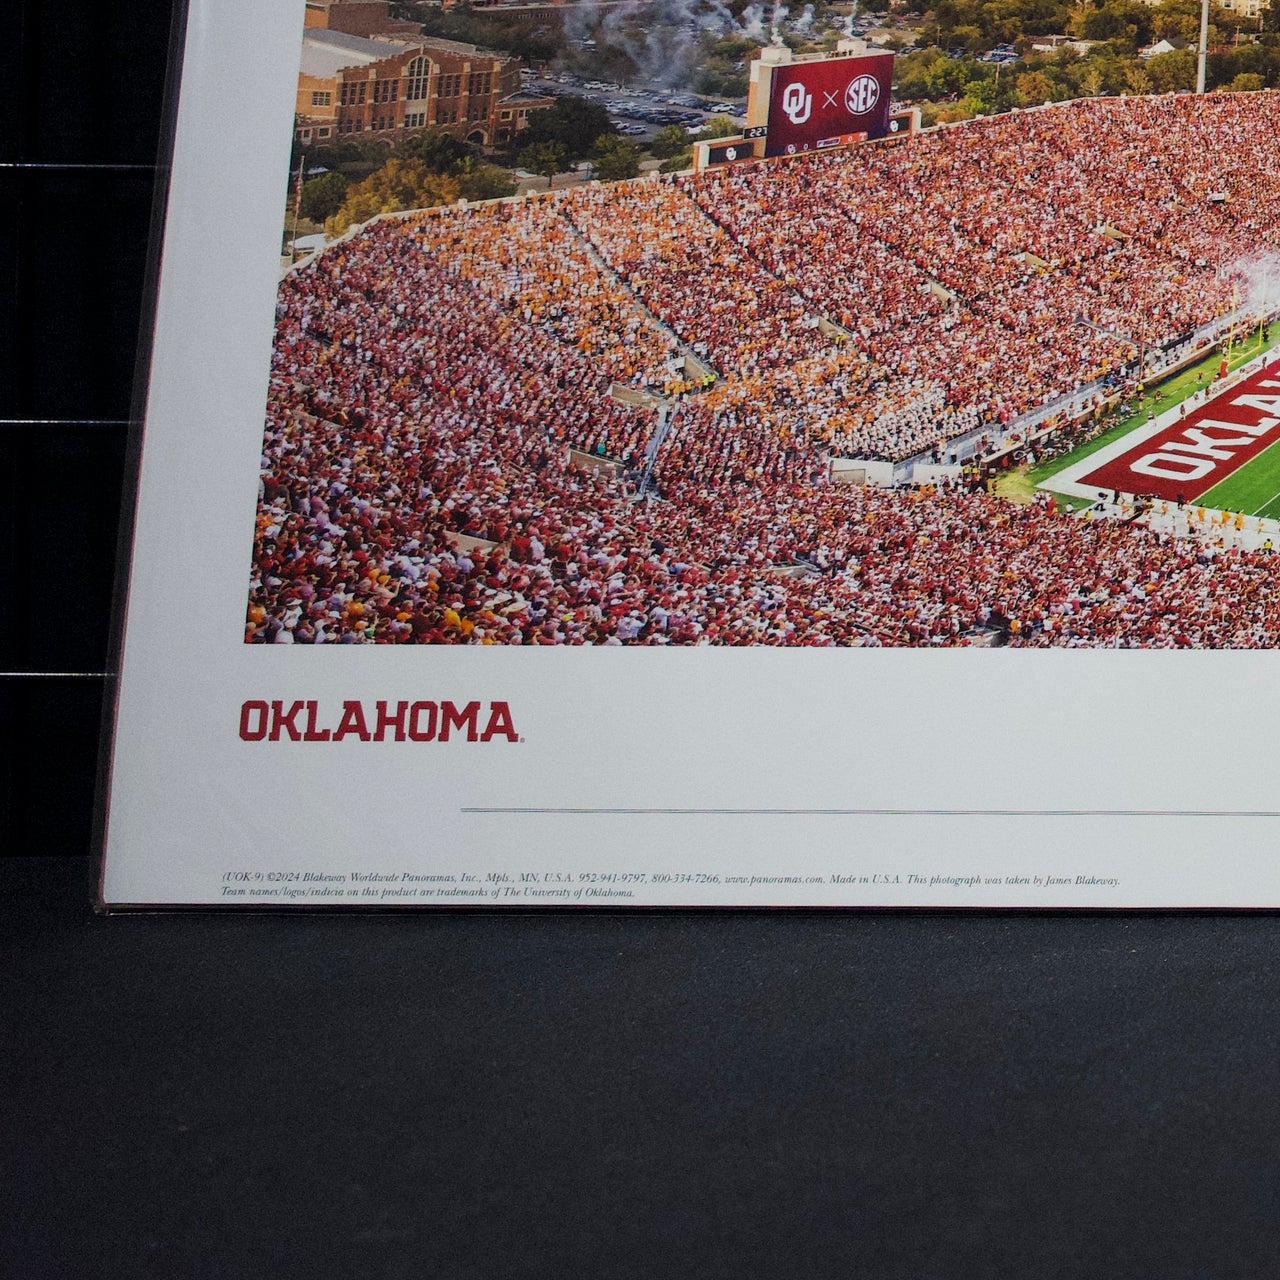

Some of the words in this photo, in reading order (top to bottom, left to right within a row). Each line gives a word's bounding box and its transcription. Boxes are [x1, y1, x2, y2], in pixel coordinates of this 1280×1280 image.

[783, 82, 812, 125] OU
[847, 76, 878, 113] SEC
[239, 700, 520, 742] OKLAHOMA
[222, 886, 246, 896] Team
[361, 887, 379, 896] this
[380, 887, 418, 899] product
[420, 889, 435, 897] are
[436, 887, 488, 897] trademarks
[490, 887, 501, 900] of
[504, 887, 521, 897] The
[523, 887, 571, 899] University
[573, 887, 584, 900] of
[585, 887, 635, 897] Oklahoma.
[302, 872, 347, 884] Blakeway
[350, 872, 399, 882] Worldwide
[401, 873, 457, 883] Panoramas,
[485, 873, 515, 886] Mpls.,
[518, 873, 540, 883] MN,
[544, 873, 575, 883] U.S.A.
[579, 873, 648, 884] 952-941-9797,
[651, 873, 722, 884] 800-334-7266,
[829, 874, 857, 884] Made
[859, 875, 869, 884] in
[872, 874, 903, 884] U.S.A.
[906, 874, 927, 884] This
[929, 875, 982, 888] photograph
[984, 877, 1002, 885] was
[1005, 876, 1030, 885] taken
[1033, 876, 1044, 888] by
[1044, 875, 1072, 887] James
[1075, 876, 1121, 888] Blakeway.
